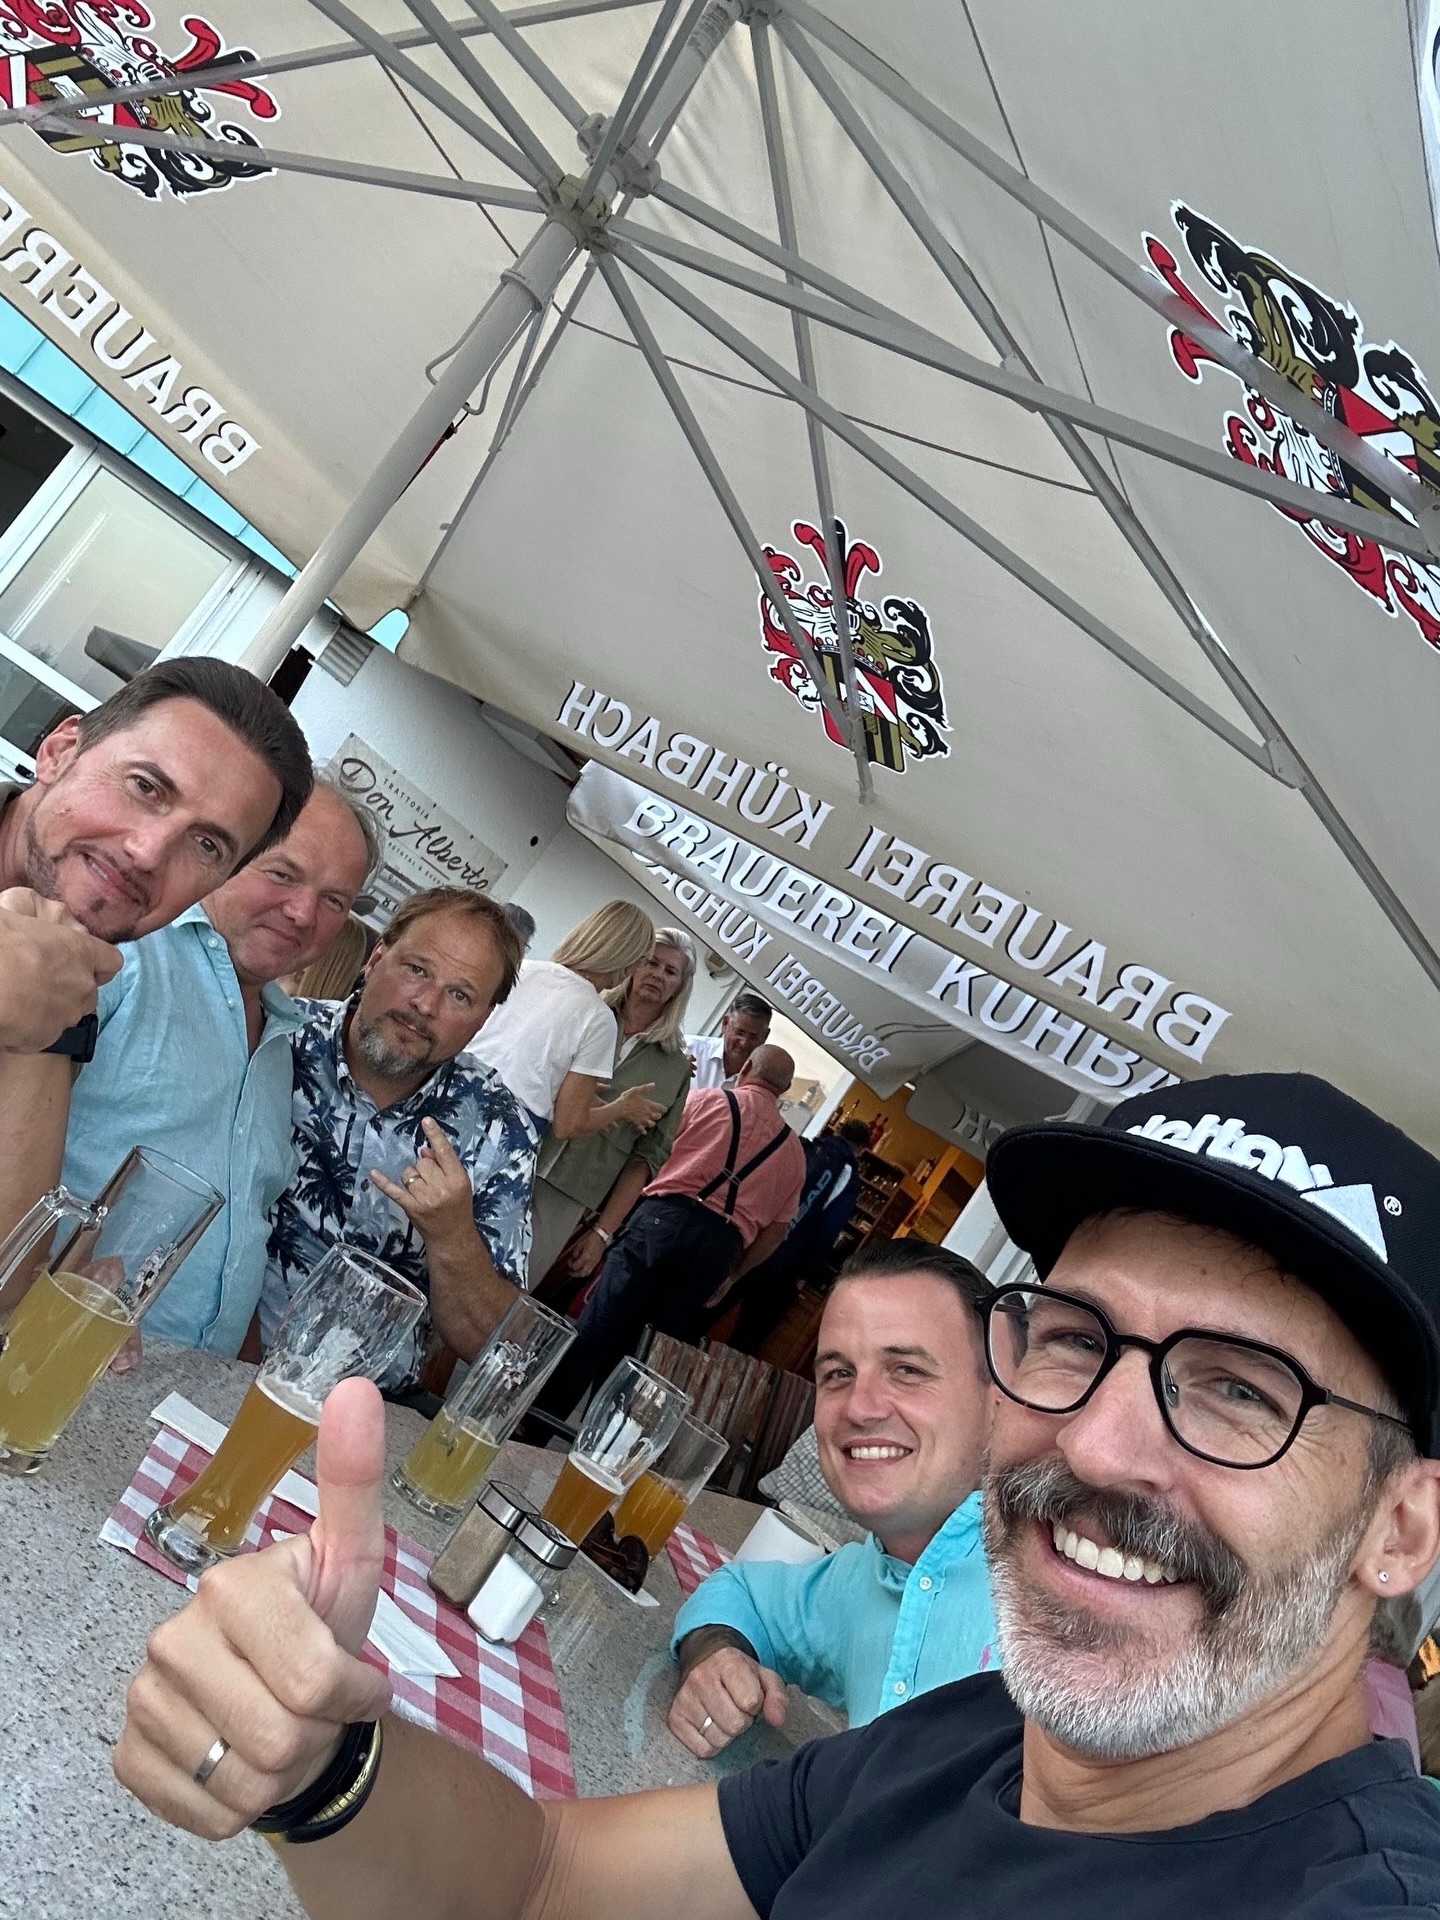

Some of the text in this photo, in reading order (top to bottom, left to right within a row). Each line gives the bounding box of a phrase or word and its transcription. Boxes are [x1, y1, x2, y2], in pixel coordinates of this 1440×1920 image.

[339, 758, 488, 890] Don Alberto
[383, 778, 430, 821] TRATTORIA
[622, 795, 920, 973] BRAUEREI
